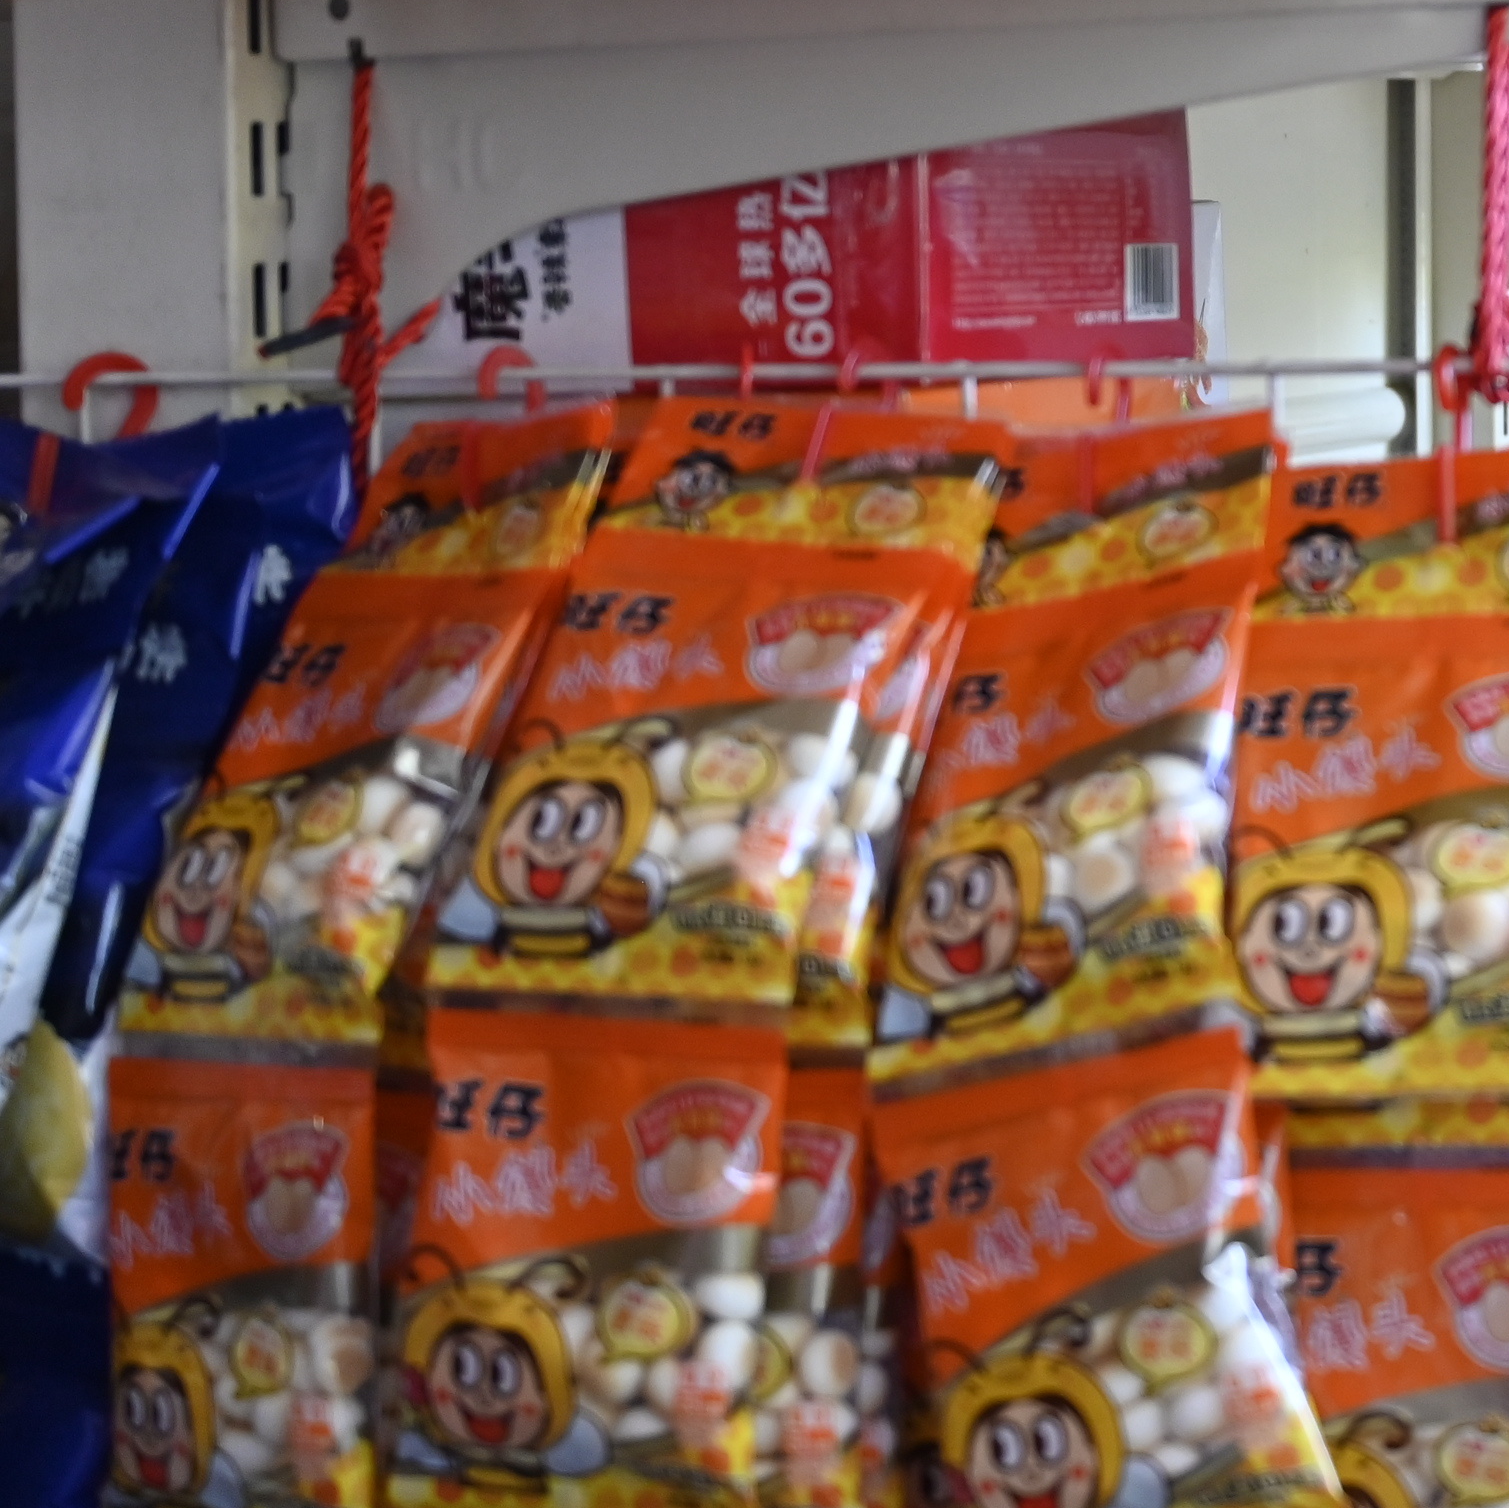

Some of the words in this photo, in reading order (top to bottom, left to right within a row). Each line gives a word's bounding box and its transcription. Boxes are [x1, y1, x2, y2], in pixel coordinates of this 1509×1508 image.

[1293, 471, 1384, 510] 旺仔
[952, 673, 1005, 716] 仔
[1240, 687, 1358, 740] 旺仔
[1296, 1238, 1343, 1296] 仔
[1307, 1287, 1437, 1372] 馒头
